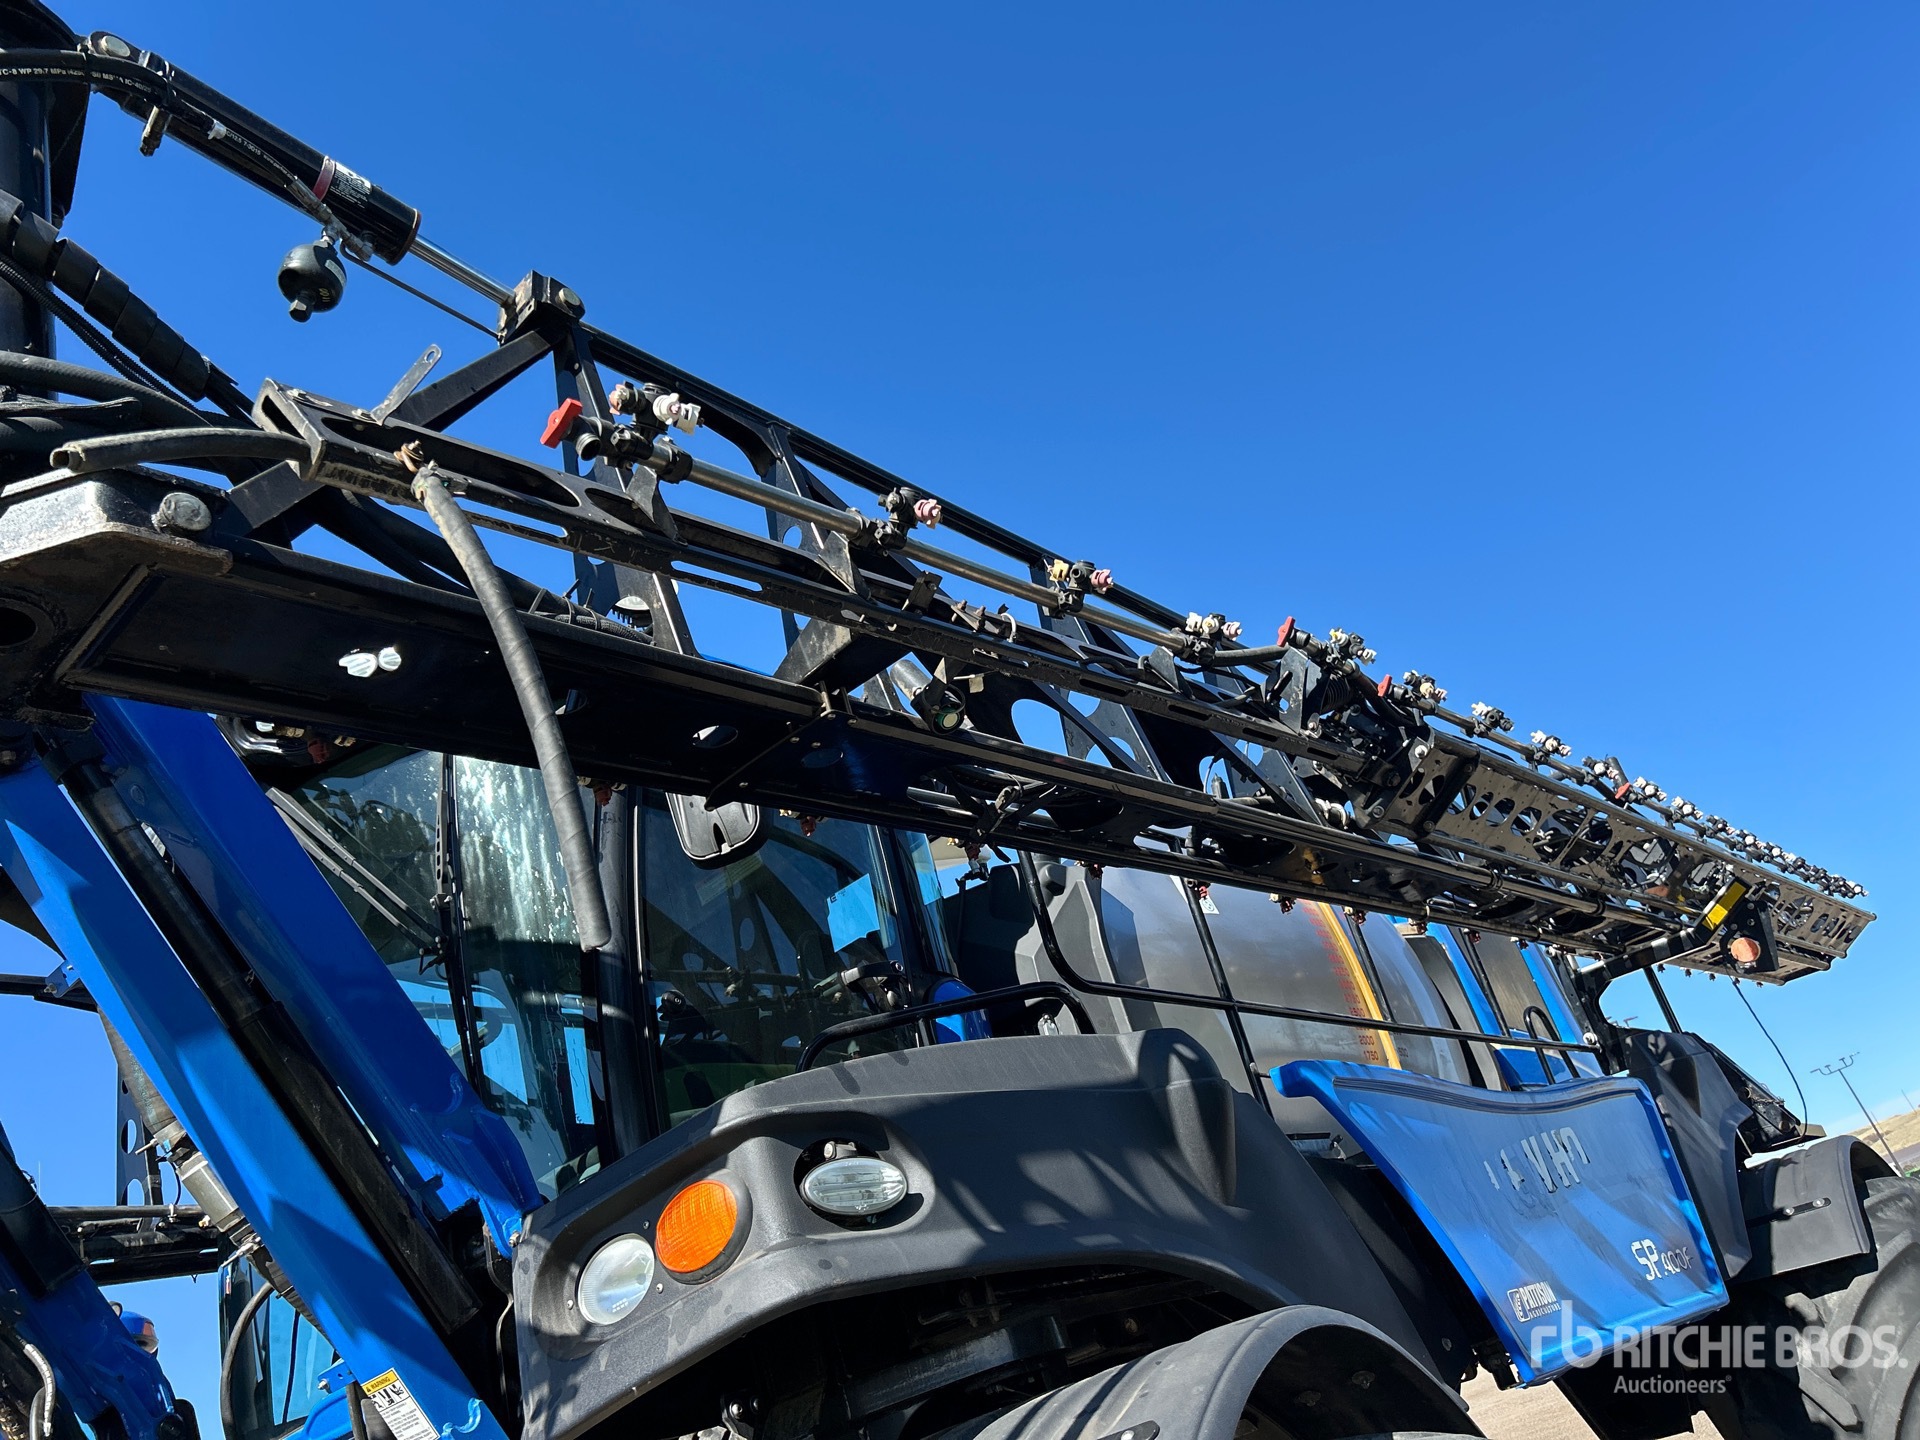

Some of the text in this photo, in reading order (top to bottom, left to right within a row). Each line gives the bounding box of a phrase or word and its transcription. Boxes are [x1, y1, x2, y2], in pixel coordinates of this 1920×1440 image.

[1358, 1035, 1374, 1046] 2000
[1363, 1051, 1379, 1061] 1750
[1519, 1280, 1558, 1309] PATTISON
[1529, 1302, 1562, 1319] AGRICULTURE
[371, 1376, 391, 1390] WARNING
